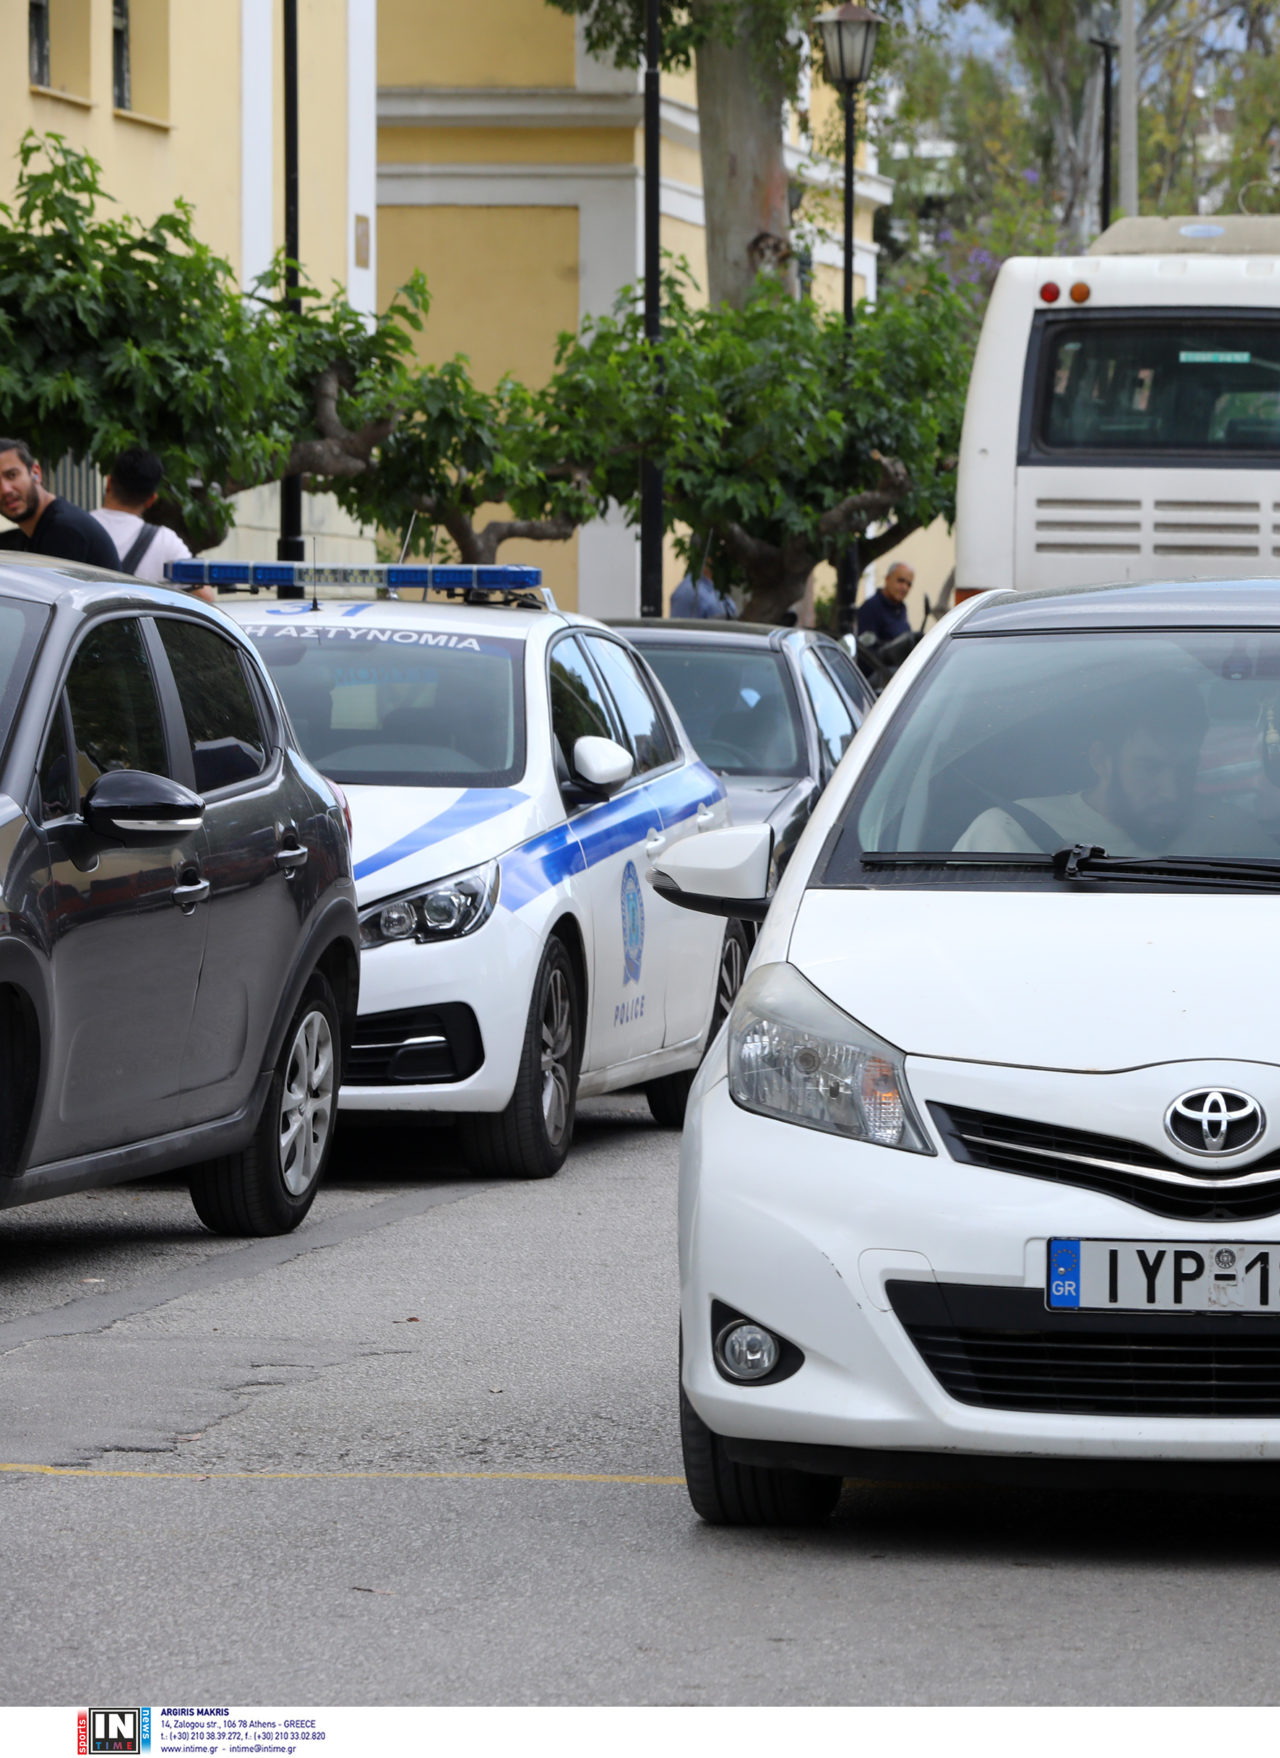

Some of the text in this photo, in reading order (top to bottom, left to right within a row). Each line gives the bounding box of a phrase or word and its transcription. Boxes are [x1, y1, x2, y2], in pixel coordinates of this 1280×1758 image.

[274, 626, 481, 651] ΑΣΤΥΝΟΜΙΑ
[614, 995, 645, 1027] POLICE
[1052, 1281, 1077, 1297] GR
